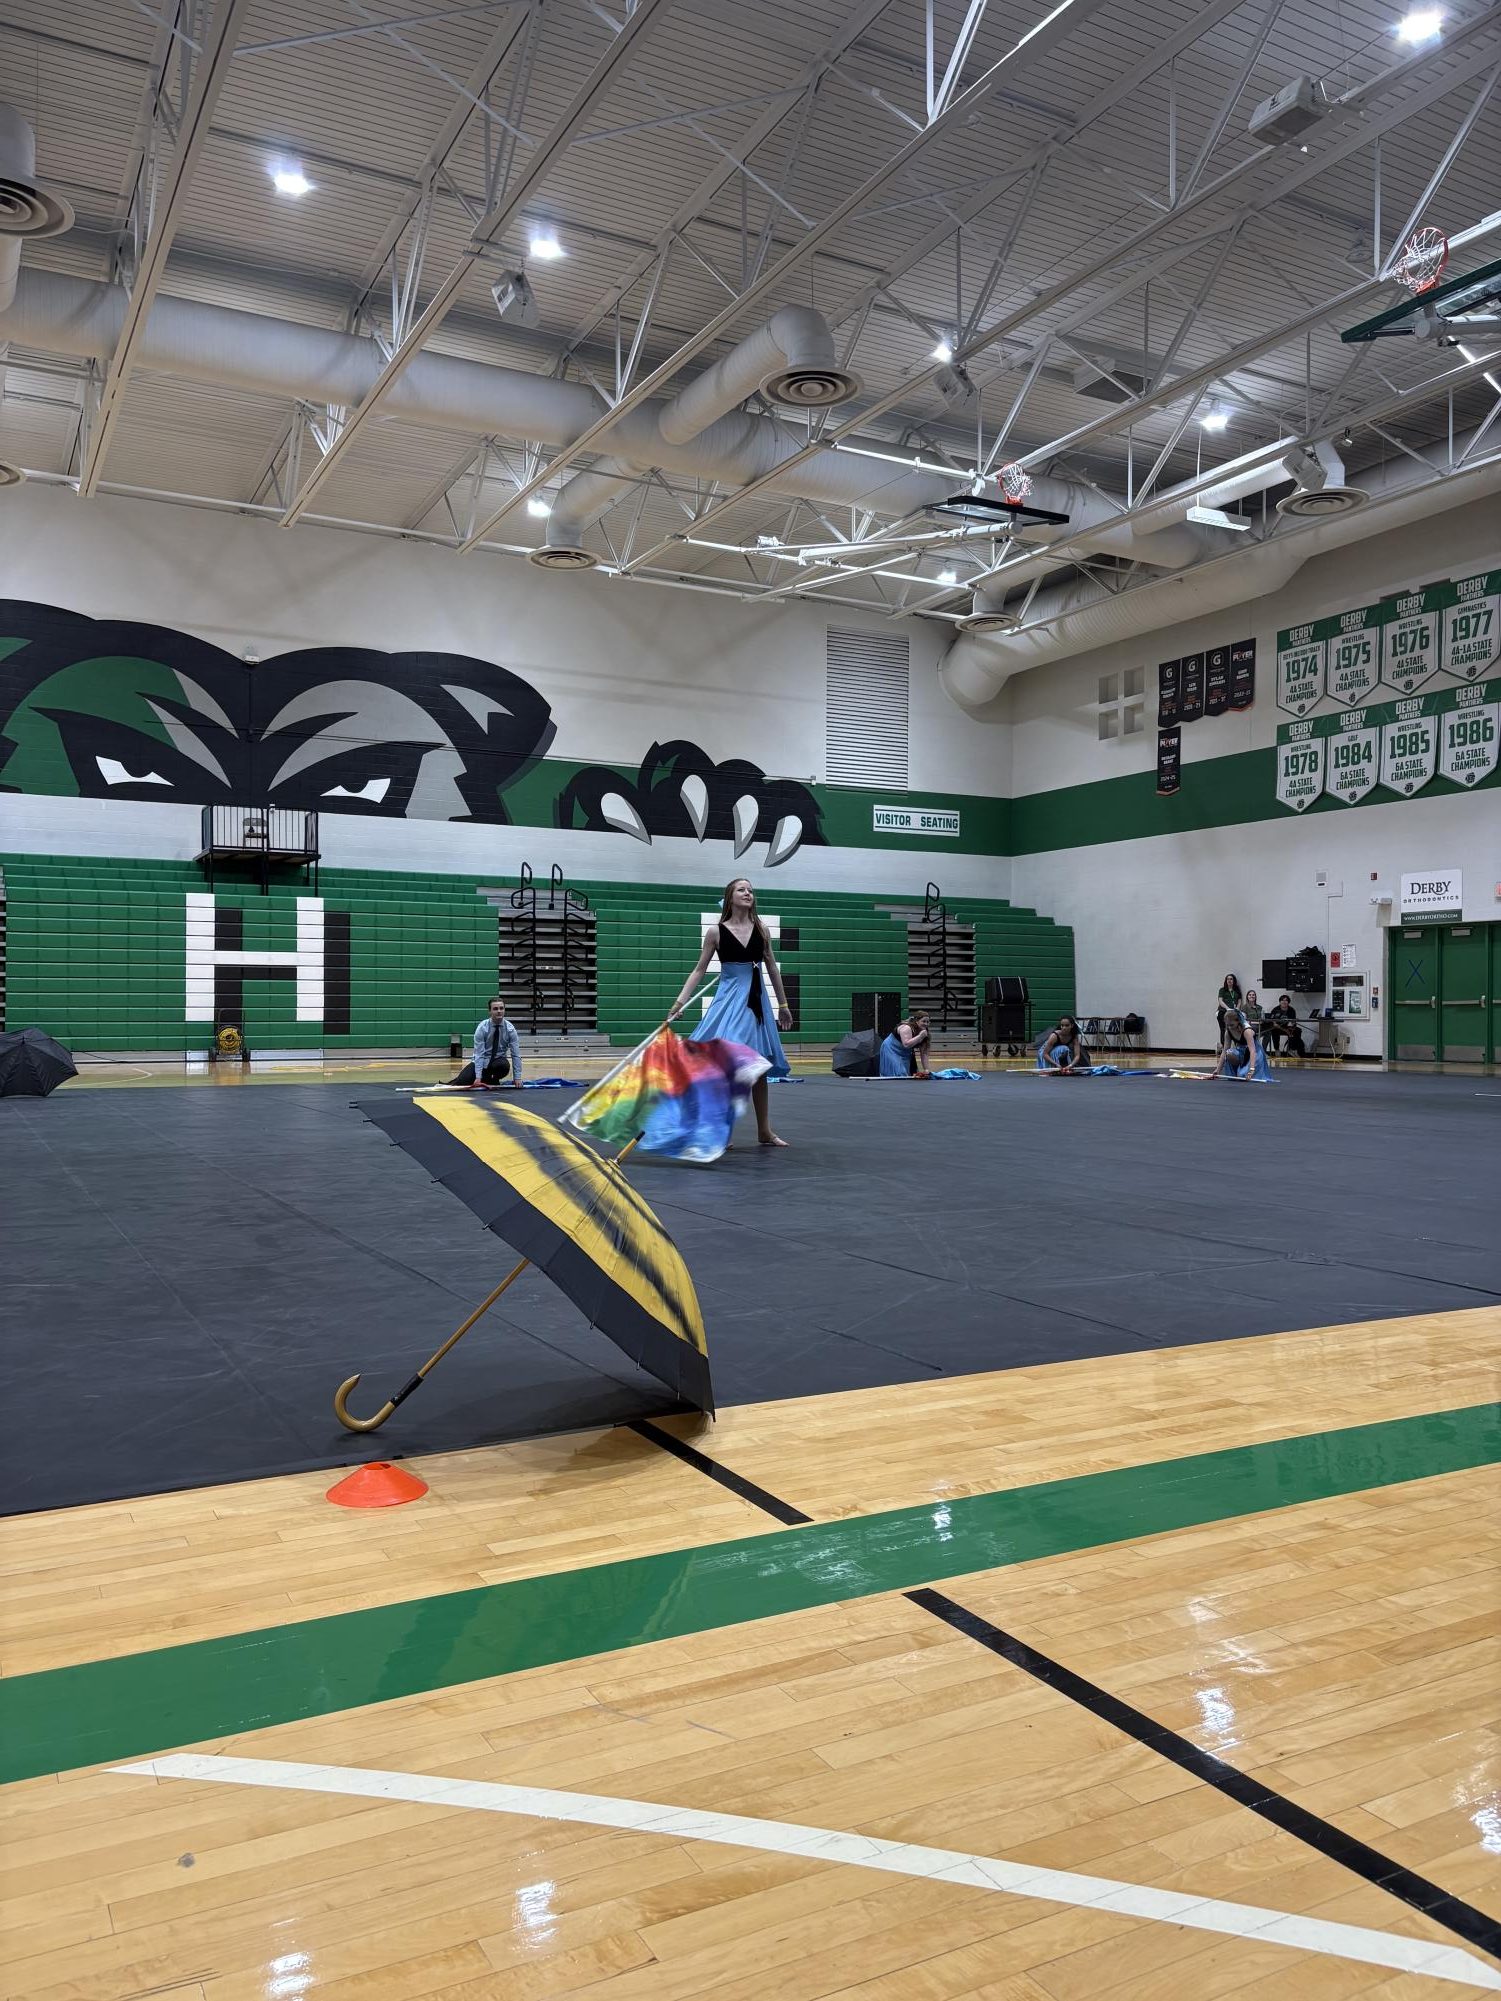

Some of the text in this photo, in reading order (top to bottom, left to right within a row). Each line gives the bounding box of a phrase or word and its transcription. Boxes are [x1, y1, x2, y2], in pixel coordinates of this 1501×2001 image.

[1457, 576, 1488, 595] DERBY
[1397, 593, 1425, 612] DERBY
[1458, 602, 1486, 614] GYMNASTICS
[1340, 610, 1366, 627] DERBY
[1399, 619, 1422, 630] WRESTLING
[1452, 609, 1493, 642] 1977
[1290, 624, 1314, 641] DERBY
[1392, 626, 1429, 657] 1976
[1452, 639, 1492, 656] 4A-1A STATE
[1213, 655, 1221, 665] G
[1335, 641, 1370, 670] 1975
[1397, 655, 1423, 668] 4A STATE
[1452, 650, 1492, 666] CHAMPIONS
[1166, 668, 1172, 678] G
[1189, 661, 1195, 671] G
[1286, 655, 1318, 683] 1974
[1393, 664, 1427, 679] CHAMPIONS
[1340, 669, 1365, 681] 4A STATE
[1298, 681, 1313, 692] STATE
[1336, 678, 1369, 692] CHAMPIONS
[1286, 690, 1317, 703] CHAMPIONS
[1456, 684, 1487, 702] DERBY
[1396, 697, 1425, 714] DERBY
[1460, 698, 1483, 708] PANTHERS
[1340, 710, 1366, 726] DERBY
[1399, 712, 1420, 720] PANTHERS
[1458, 710, 1484, 720] WRESTLING
[1289, 721, 1313, 736] DERBY
[1398, 722, 1422, 732] WRESTLING
[1449, 717, 1494, 748] 1986
[1390, 730, 1430, 759] 1985
[1334, 741, 1372, 769] 1984
[1456, 748, 1485, 761] 6A STATE
[1284, 751, 1318, 777] 1978
[1396, 759, 1423, 771] 6A STATE
[1451, 757, 1490, 771] CHAMPIONS
[1341, 768, 1365, 780] 6A STATE
[1391, 768, 1427, 781] CHAMPIONS
[1289, 777, 1312, 788] 4A STATE
[1336, 777, 1369, 790] CHAMPIONS
[1286, 786, 1316, 798] CHAMPIONS
[876, 813, 958, 829] VISITOR SEATING
[1410, 881, 1451, 895] DERBY
[186, 892, 324, 1022] H
